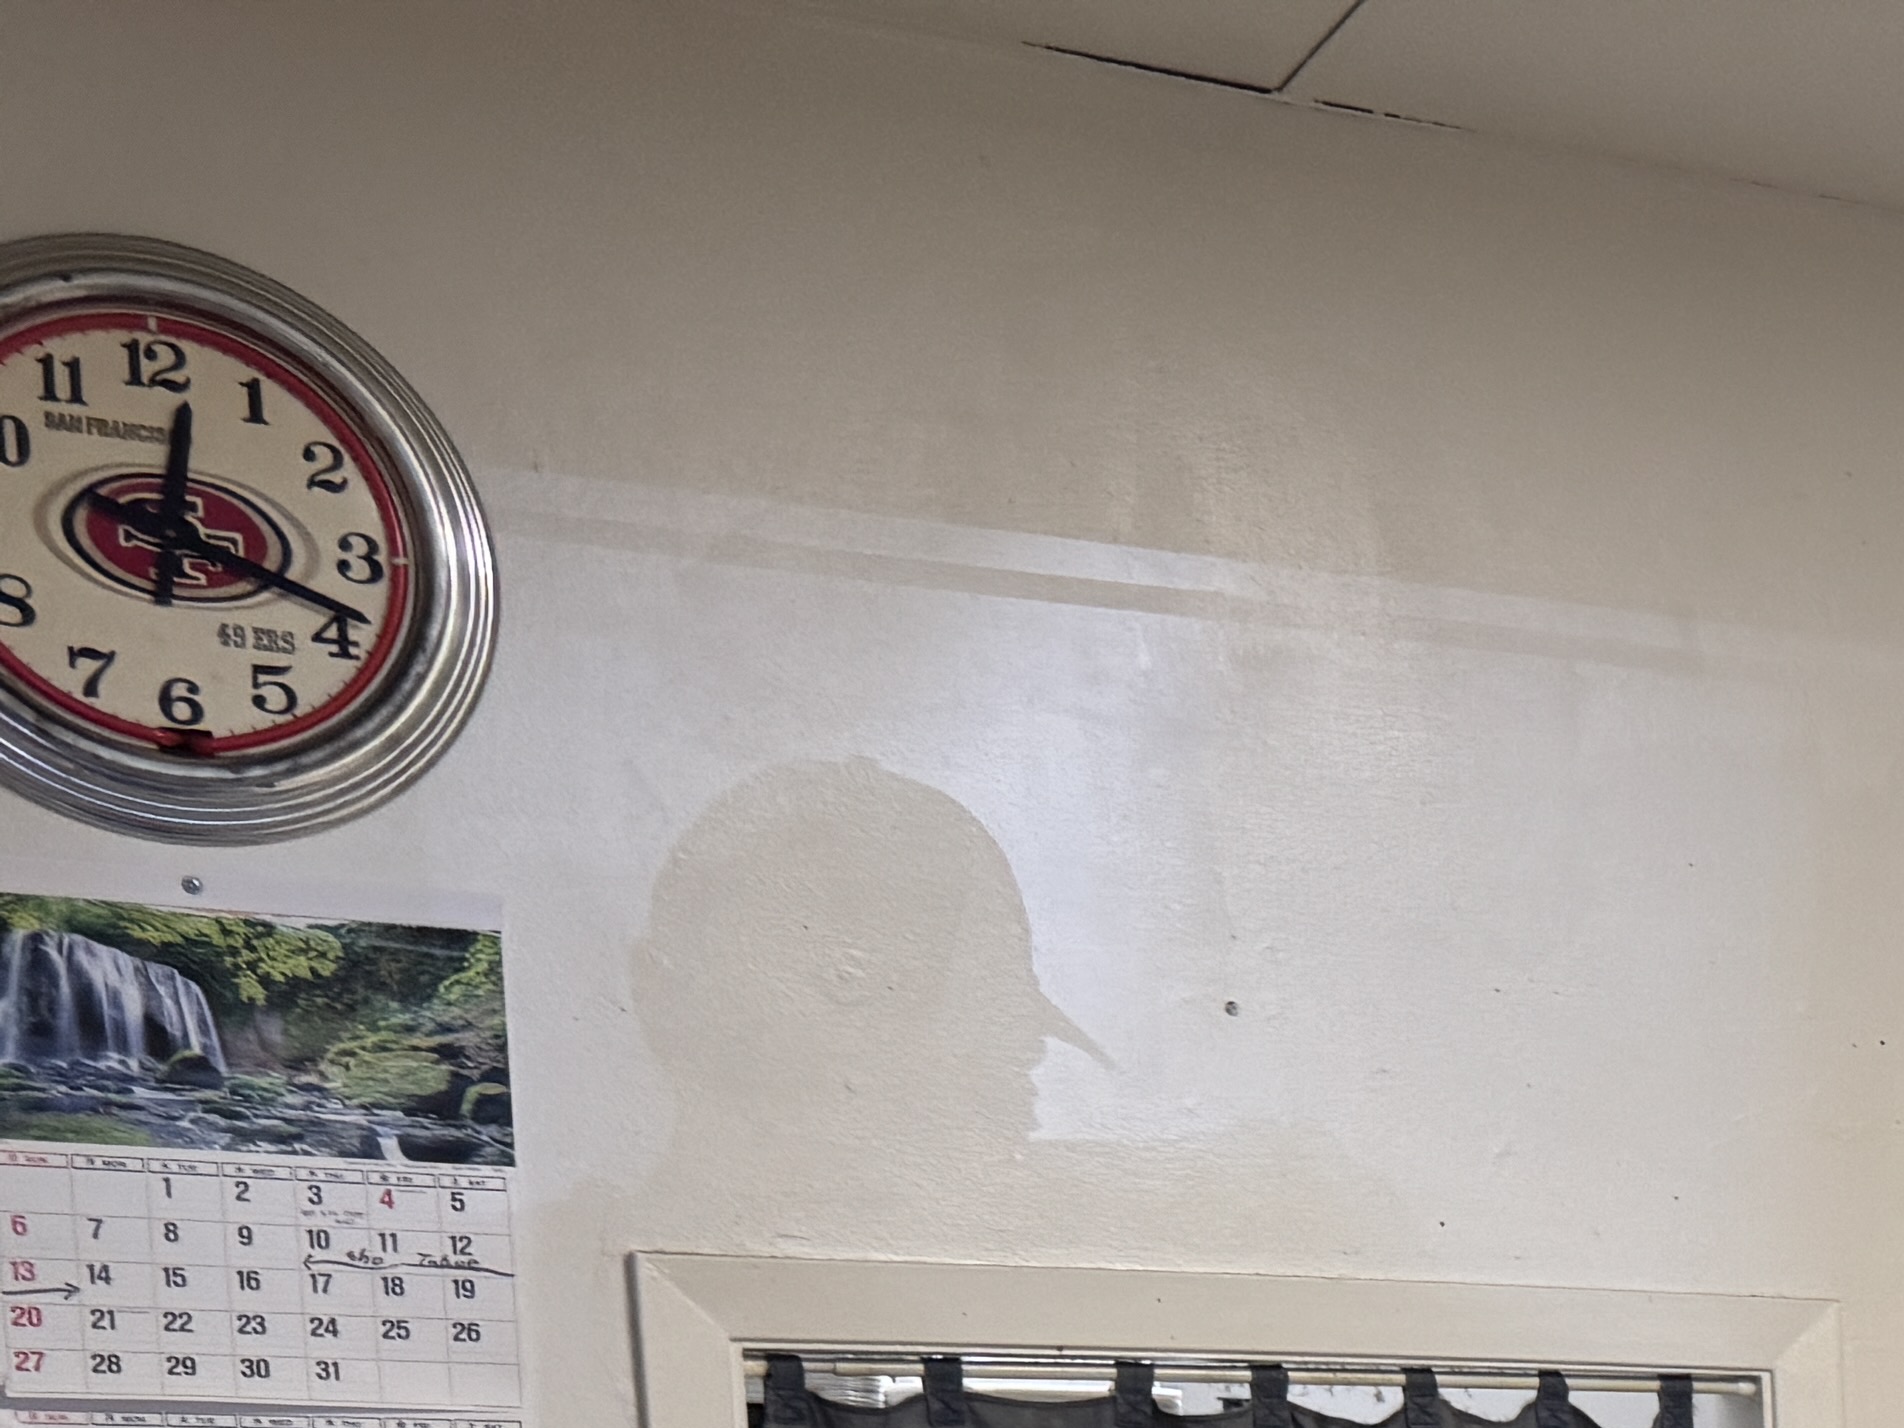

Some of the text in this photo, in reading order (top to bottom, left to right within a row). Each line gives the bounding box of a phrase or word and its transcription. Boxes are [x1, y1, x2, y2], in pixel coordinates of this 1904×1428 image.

[35, 352, 89, 407] 11
[121, 338, 191, 392] 12
[238, 376, 270, 426] 1
[0, 415, 31, 467] 0
[85, 415, 170, 445] FRANCIS
[302, 441, 348, 494] 2
[336, 531, 384, 584] 3
[311, 613, 361, 661] 4
[67, 645, 116, 698] 7
[251, 664, 298, 715] 5
[158, 677, 204, 726] 6
[162, 1177, 465, 1212] 1 2 3 4 5
[10, 1215, 472, 1256] 6 7 8 9 10 11 12
[10, 1261, 475, 1299] 13 14 15 16 17 18 19
[10, 1306, 481, 1343] 20 21 22 23 24 25 26
[13, 1352, 341, 1381] 27 28 29 30 31
